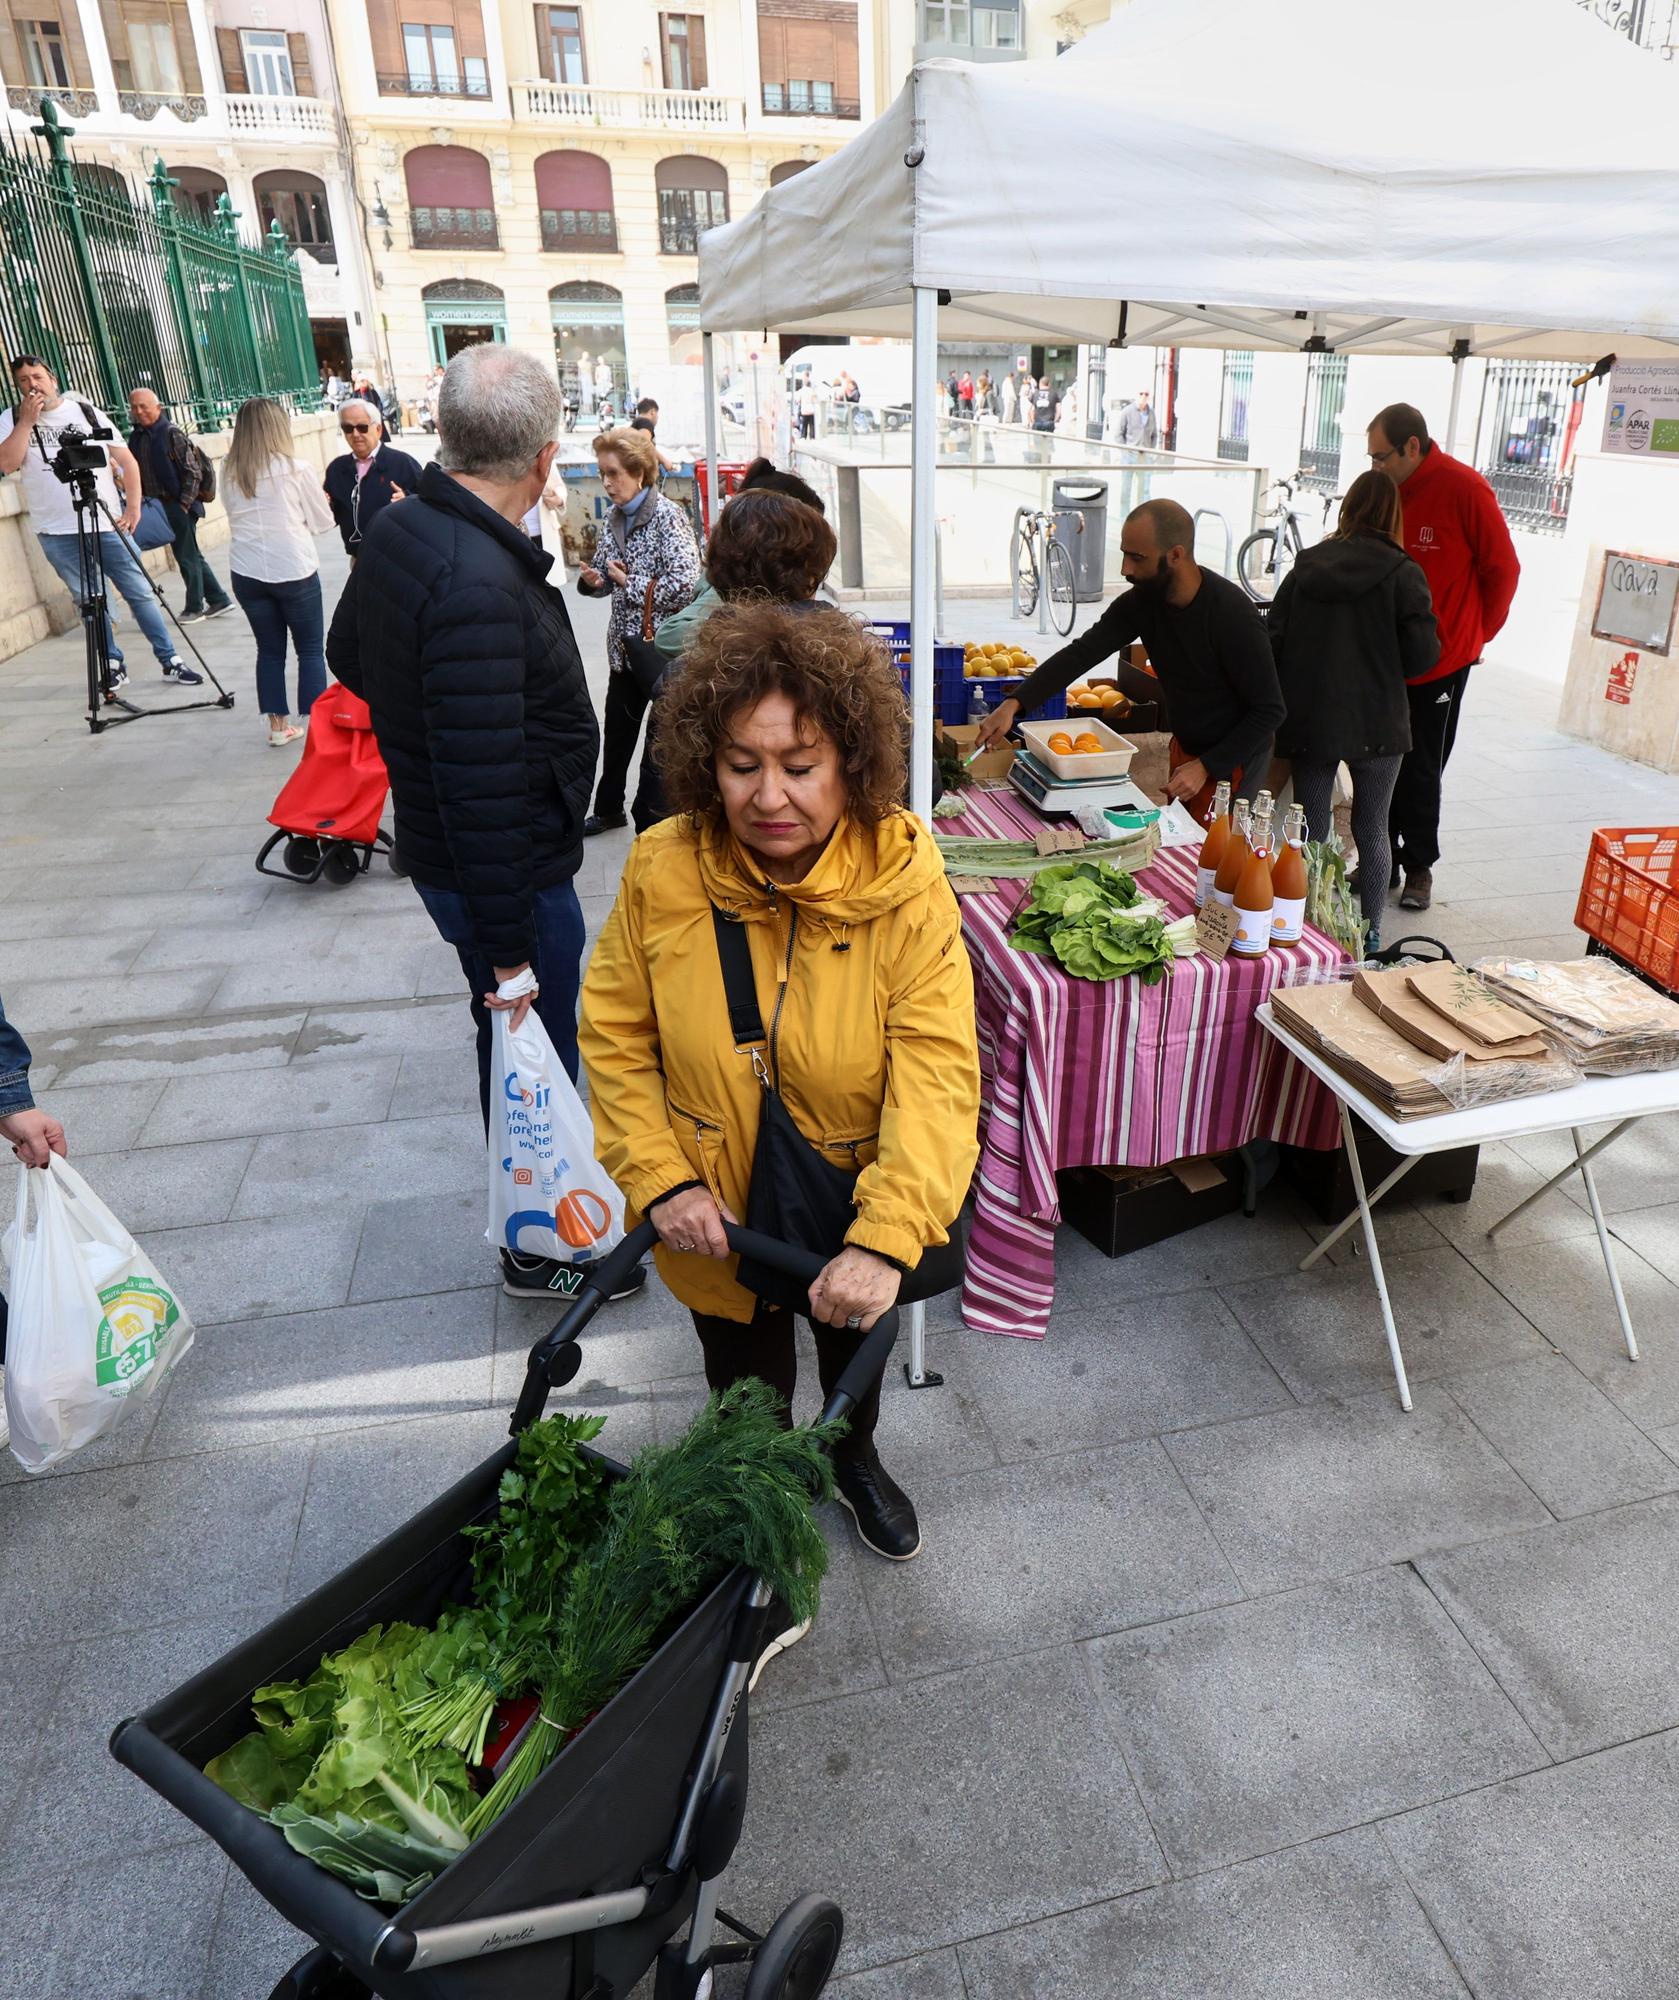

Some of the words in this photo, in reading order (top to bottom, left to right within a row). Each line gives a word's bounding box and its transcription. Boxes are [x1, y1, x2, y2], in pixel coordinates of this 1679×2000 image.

[1611, 385, 1637, 394] Juanfra
[1638, 386, 1662, 395] Cortés
[1627, 419, 1650, 430] APAR
[548, 1268, 583, 1294] N
